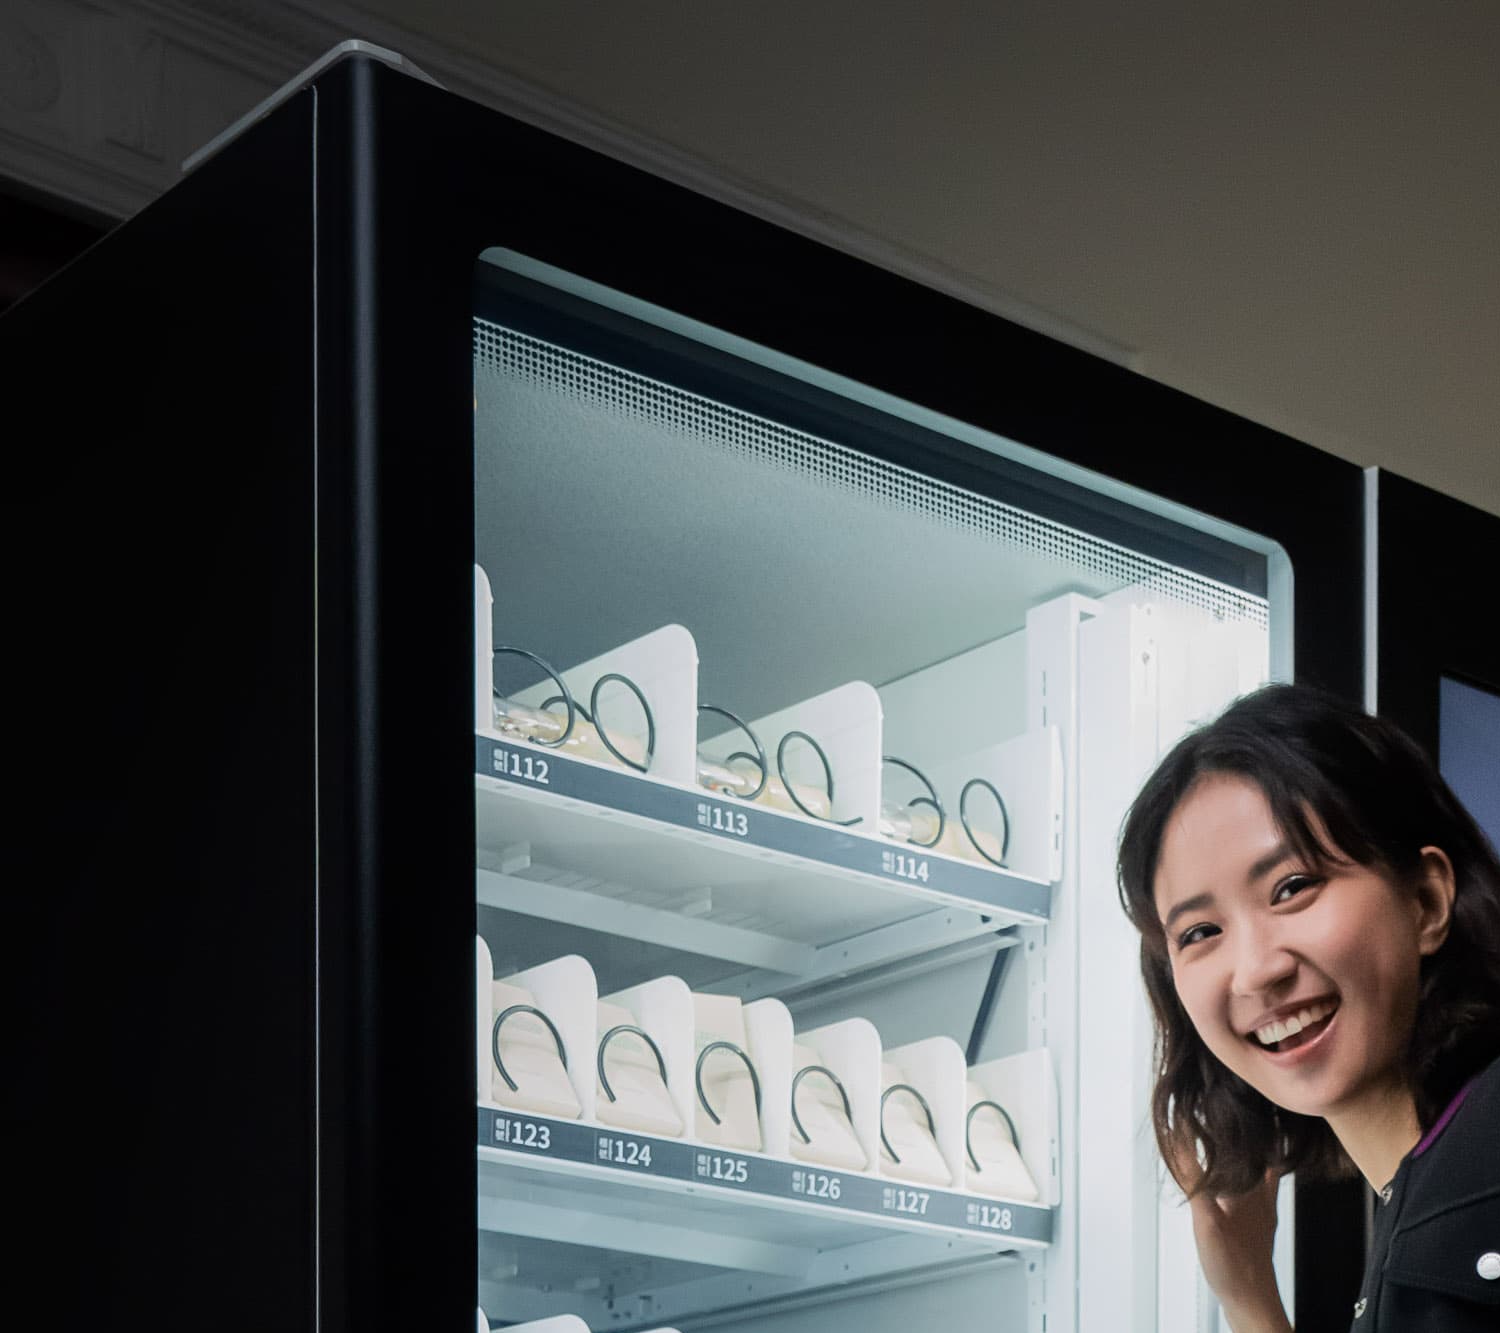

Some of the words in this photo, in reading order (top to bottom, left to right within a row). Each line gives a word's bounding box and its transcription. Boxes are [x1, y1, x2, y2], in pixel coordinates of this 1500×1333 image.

[509, 752, 550, 785] 112
[711, 806, 749, 836] 113
[897, 854, 930, 882] 114
[511, 1120, 551, 1149] 123
[614, 1138, 652, 1167] 124
[712, 1157, 748, 1183] 125
[806, 1174, 841, 1200] 126
[897, 1190, 930, 1214] 127
[979, 1204, 1013, 1230] 128
